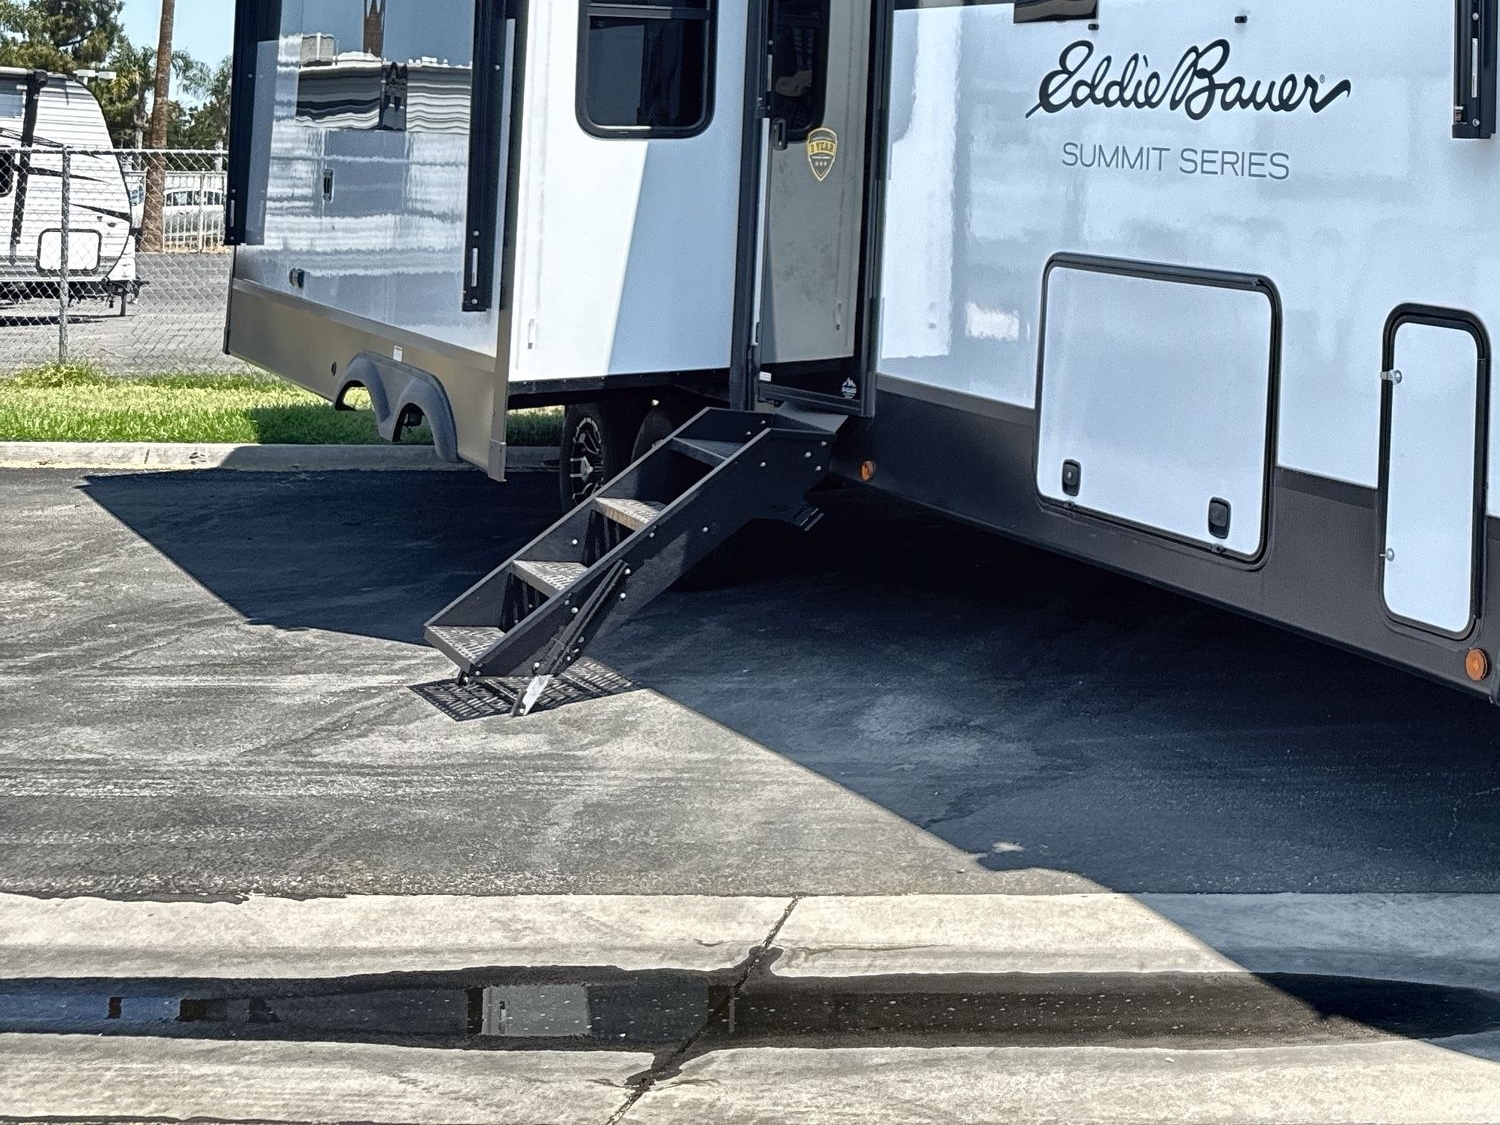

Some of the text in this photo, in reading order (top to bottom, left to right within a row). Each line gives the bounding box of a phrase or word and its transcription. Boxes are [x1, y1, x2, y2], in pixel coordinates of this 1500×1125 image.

[1025, 38, 1352, 121] Eddie Bauer
[816, 141, 834, 153] YEAR
[1062, 141, 1290, 180] SUMMIT SERIES
